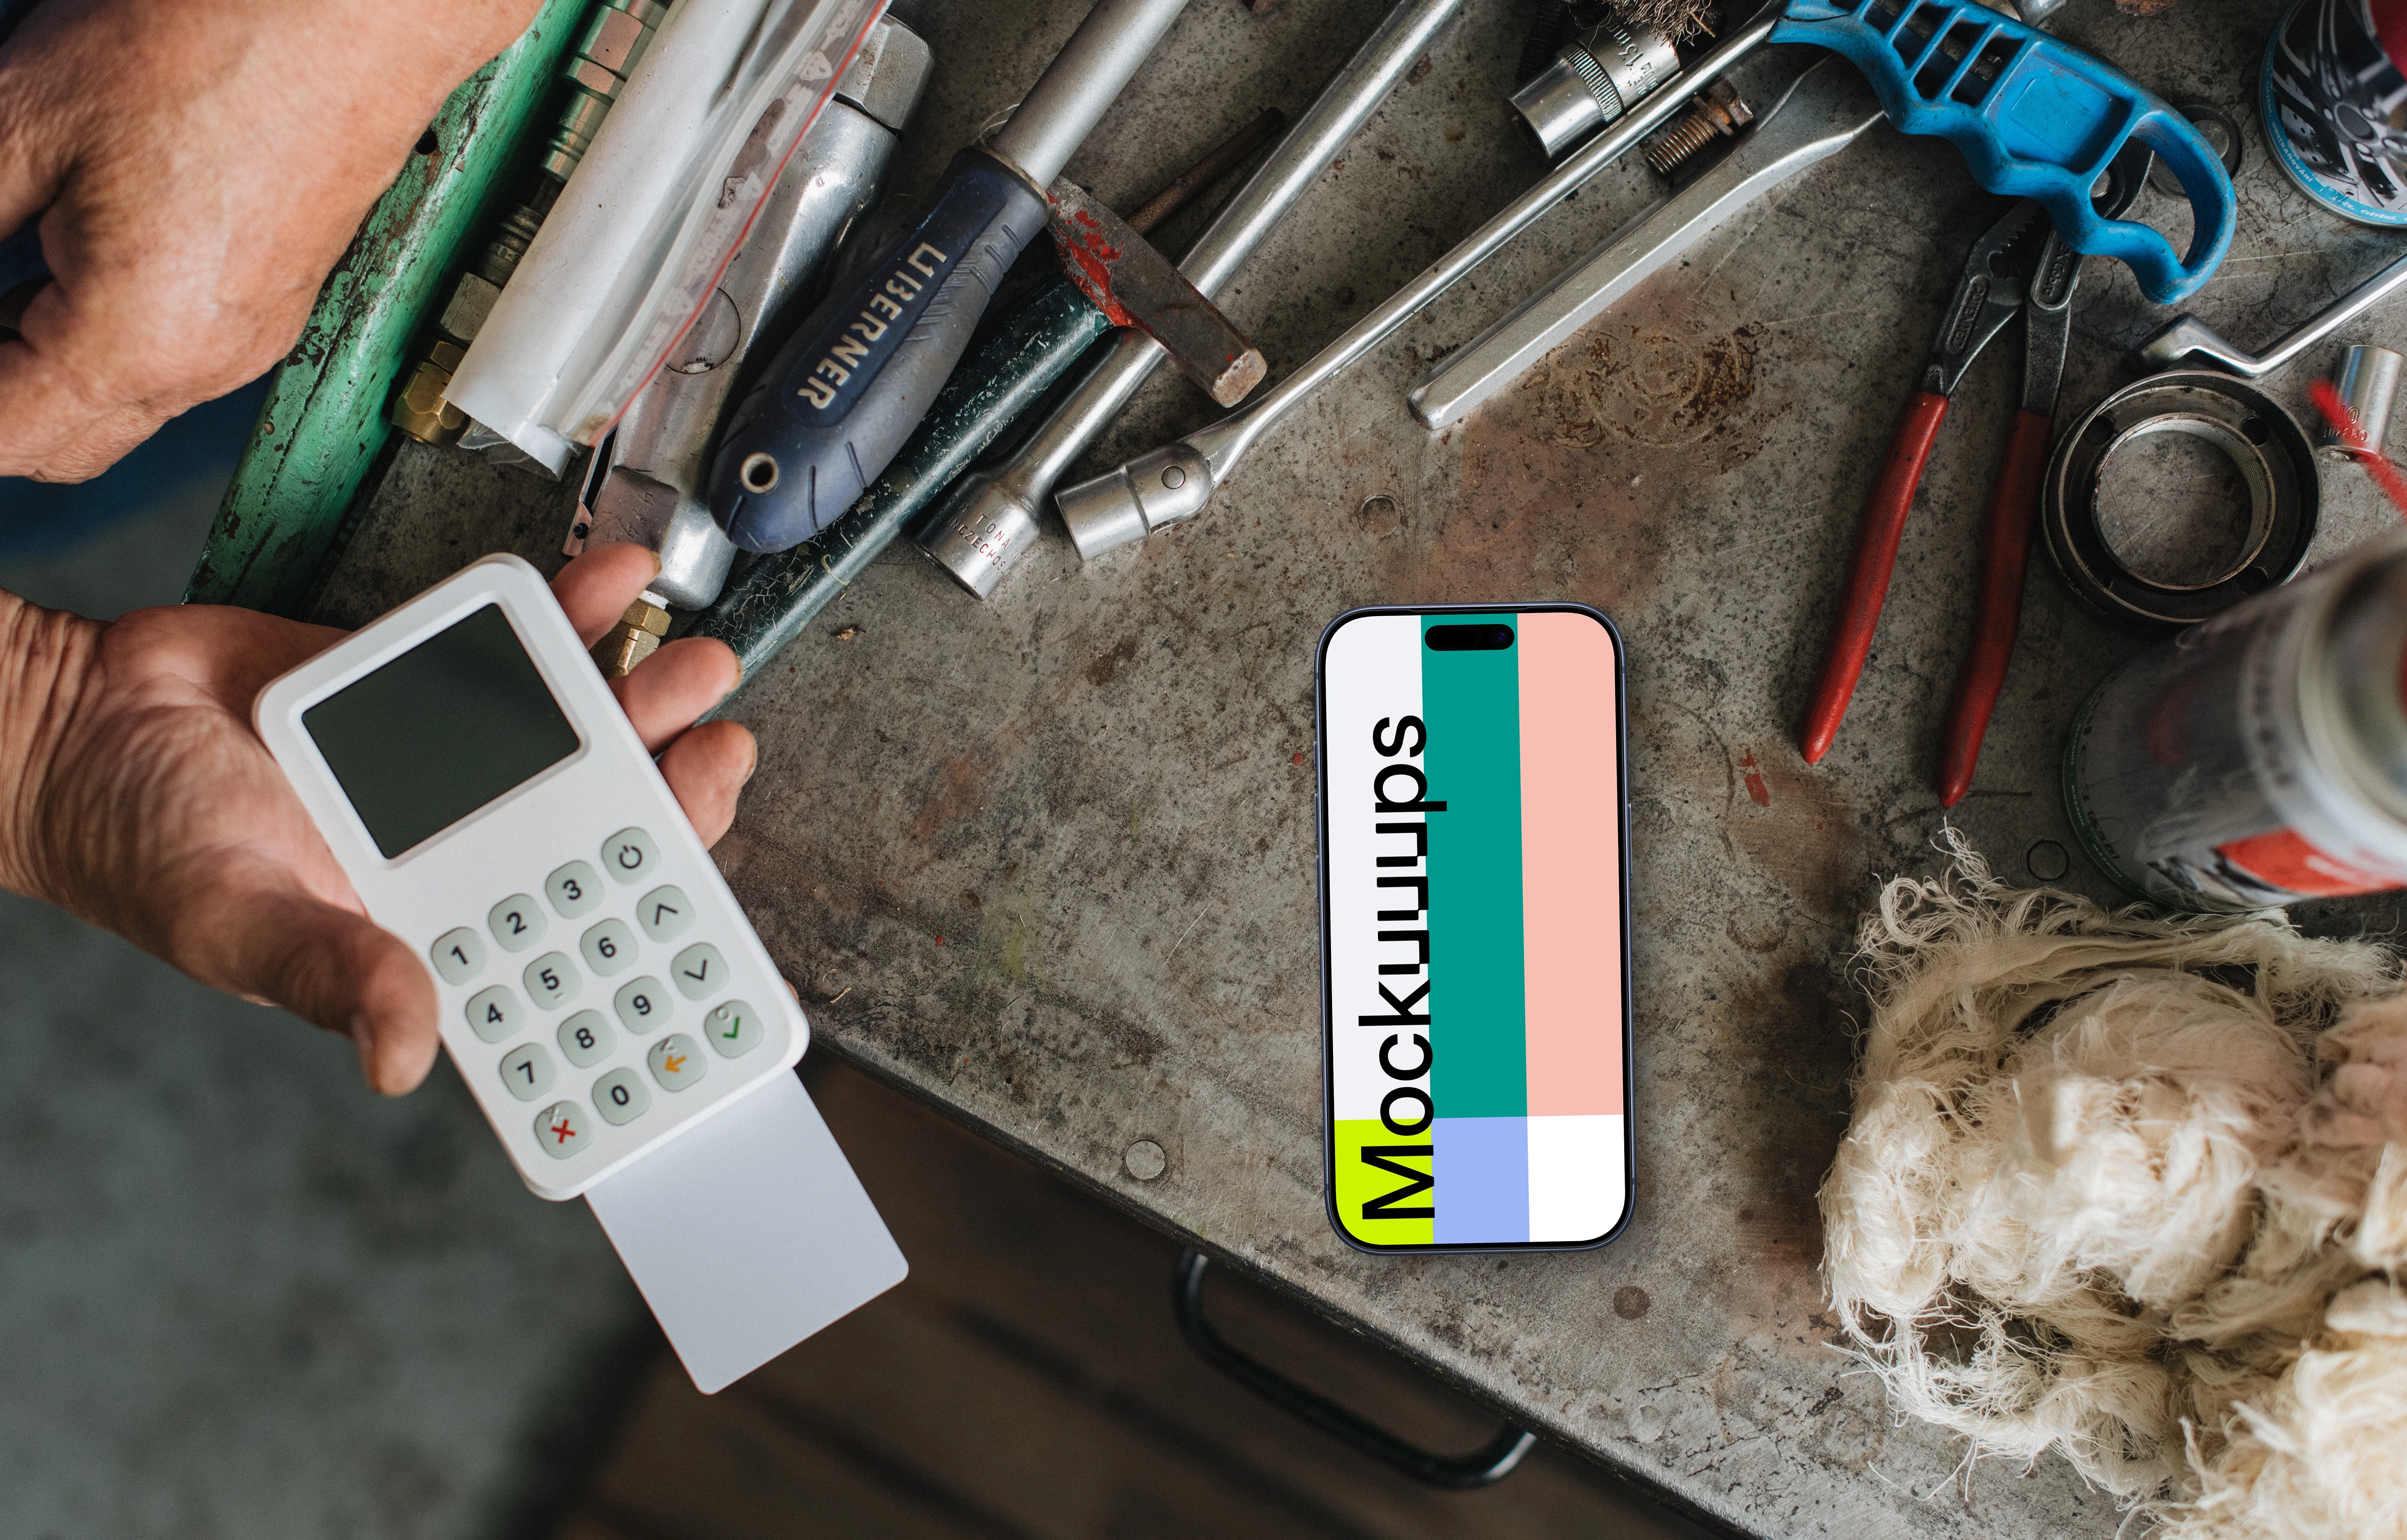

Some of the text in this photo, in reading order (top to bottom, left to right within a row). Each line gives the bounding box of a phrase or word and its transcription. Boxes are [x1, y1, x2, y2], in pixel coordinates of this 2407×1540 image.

[1952, 285, 1985, 348] PATENTED
[2337, 406, 2360, 424] 10
[976, 513, 1011, 549] TONA
[451, 879, 581, 964] 1 2 3
[488, 937, 616, 1023] 4 5 6
[1359, 716, 1447, 1219] Mockuuups
[517, 995, 650, 1084] 7 8 9
[611, 1085, 629, 1106] 0
